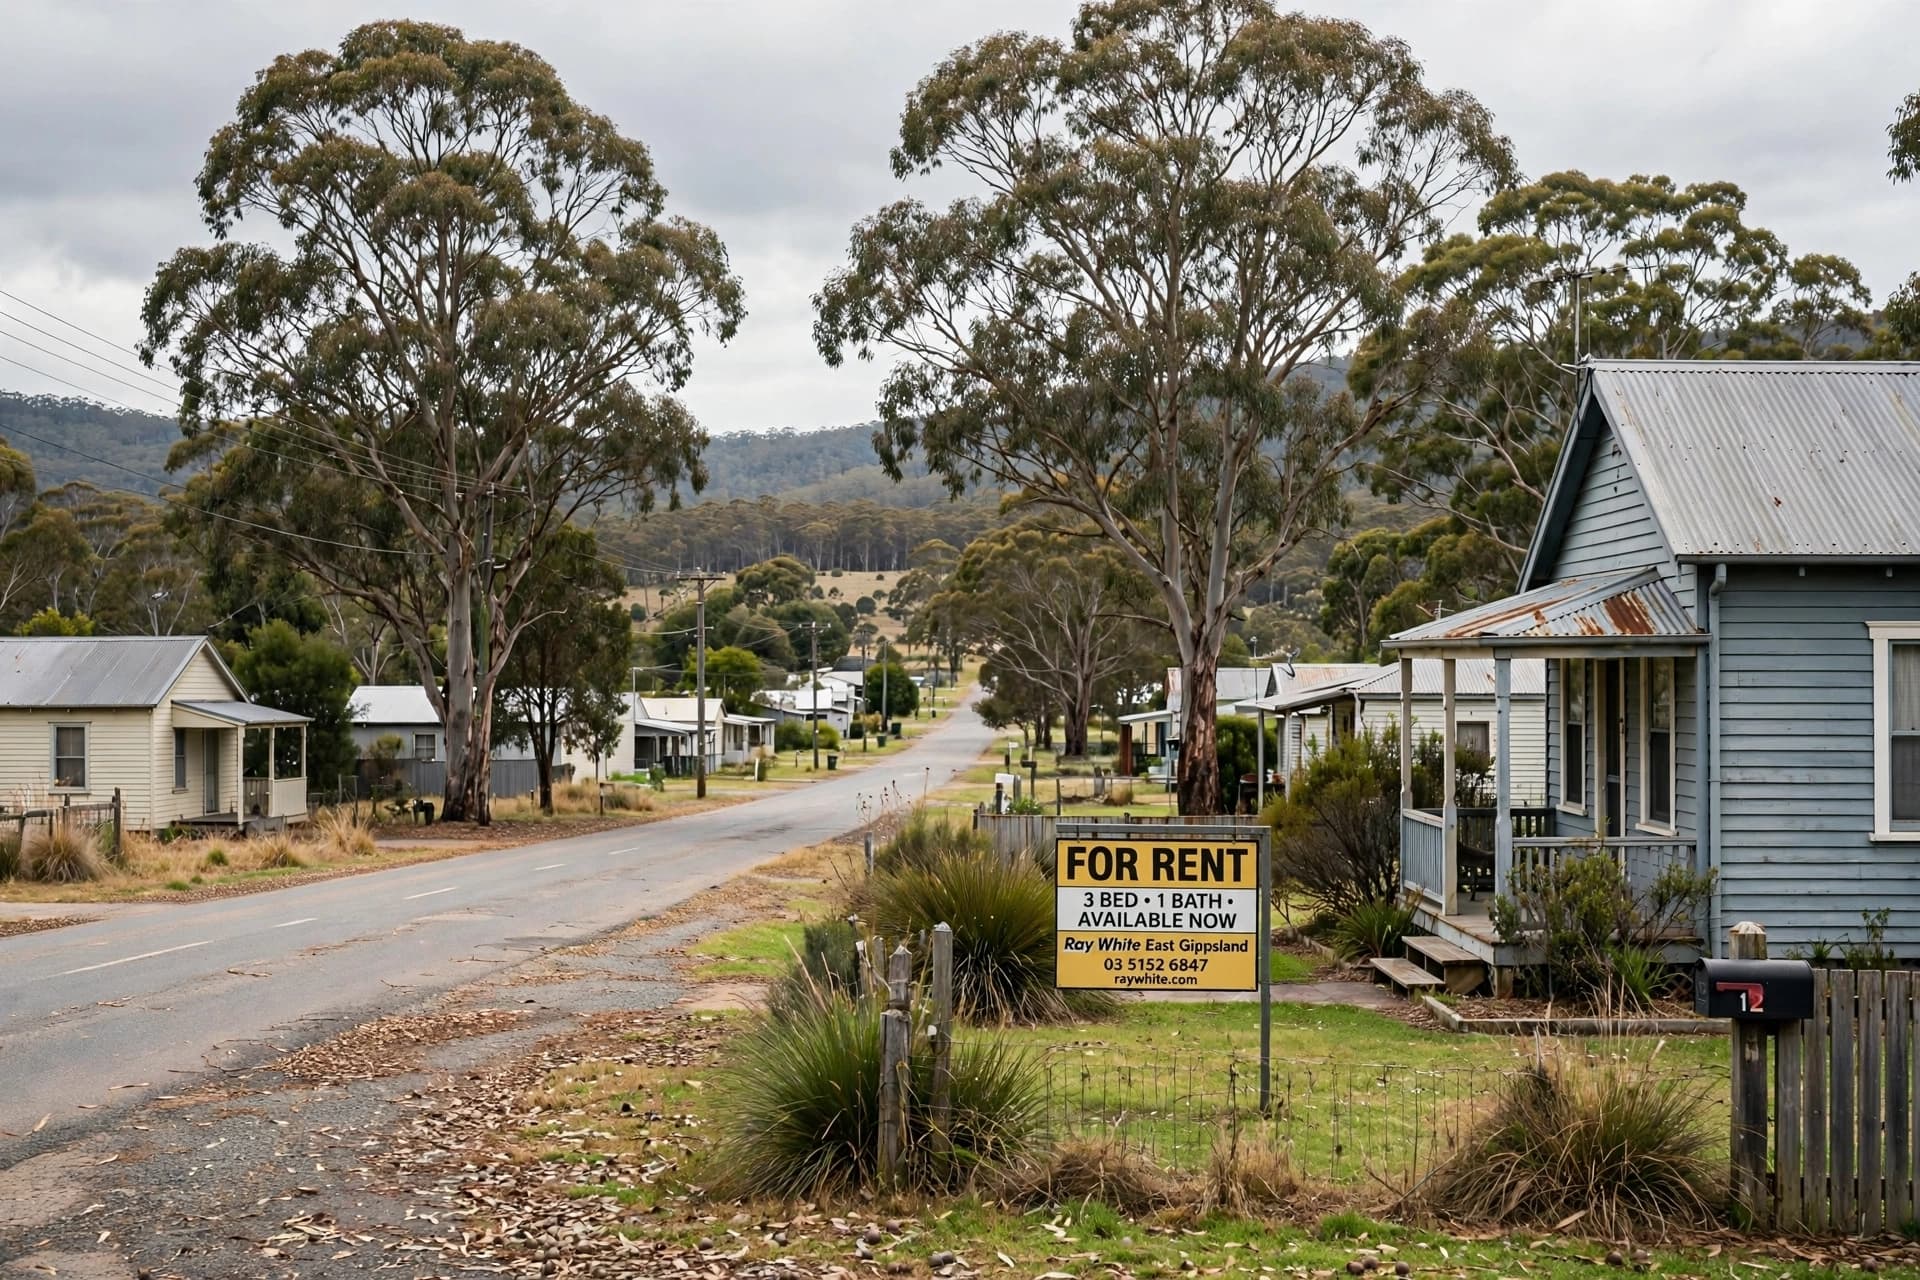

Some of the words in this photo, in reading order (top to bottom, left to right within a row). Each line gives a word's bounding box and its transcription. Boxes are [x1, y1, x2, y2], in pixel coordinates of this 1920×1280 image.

[1067, 846, 1138, 881] FOR
[1153, 848, 1248, 882] RENT
[1084, 892, 1094, 907] 3
[1101, 892, 1138, 907] BED
[1158, 893, 1163, 907] 1
[1172, 893, 1221, 909] BATH
[1078, 912, 1183, 928] AVAILABLE
[1190, 913, 1236, 928] NOW
[1065, 937, 1094, 953] Ray
[1099, 938, 1141, 951] White
[1146, 939, 1174, 951] East
[1179, 939, 1248, 955] Gippsland
[1104, 958, 1122, 970] 03
[1128, 958, 1164, 971] 5152
[1169, 959, 1208, 971] 6847
[1115, 973, 1197, 986] raywhite.com
[1740, 992, 1764, 1012] 12
